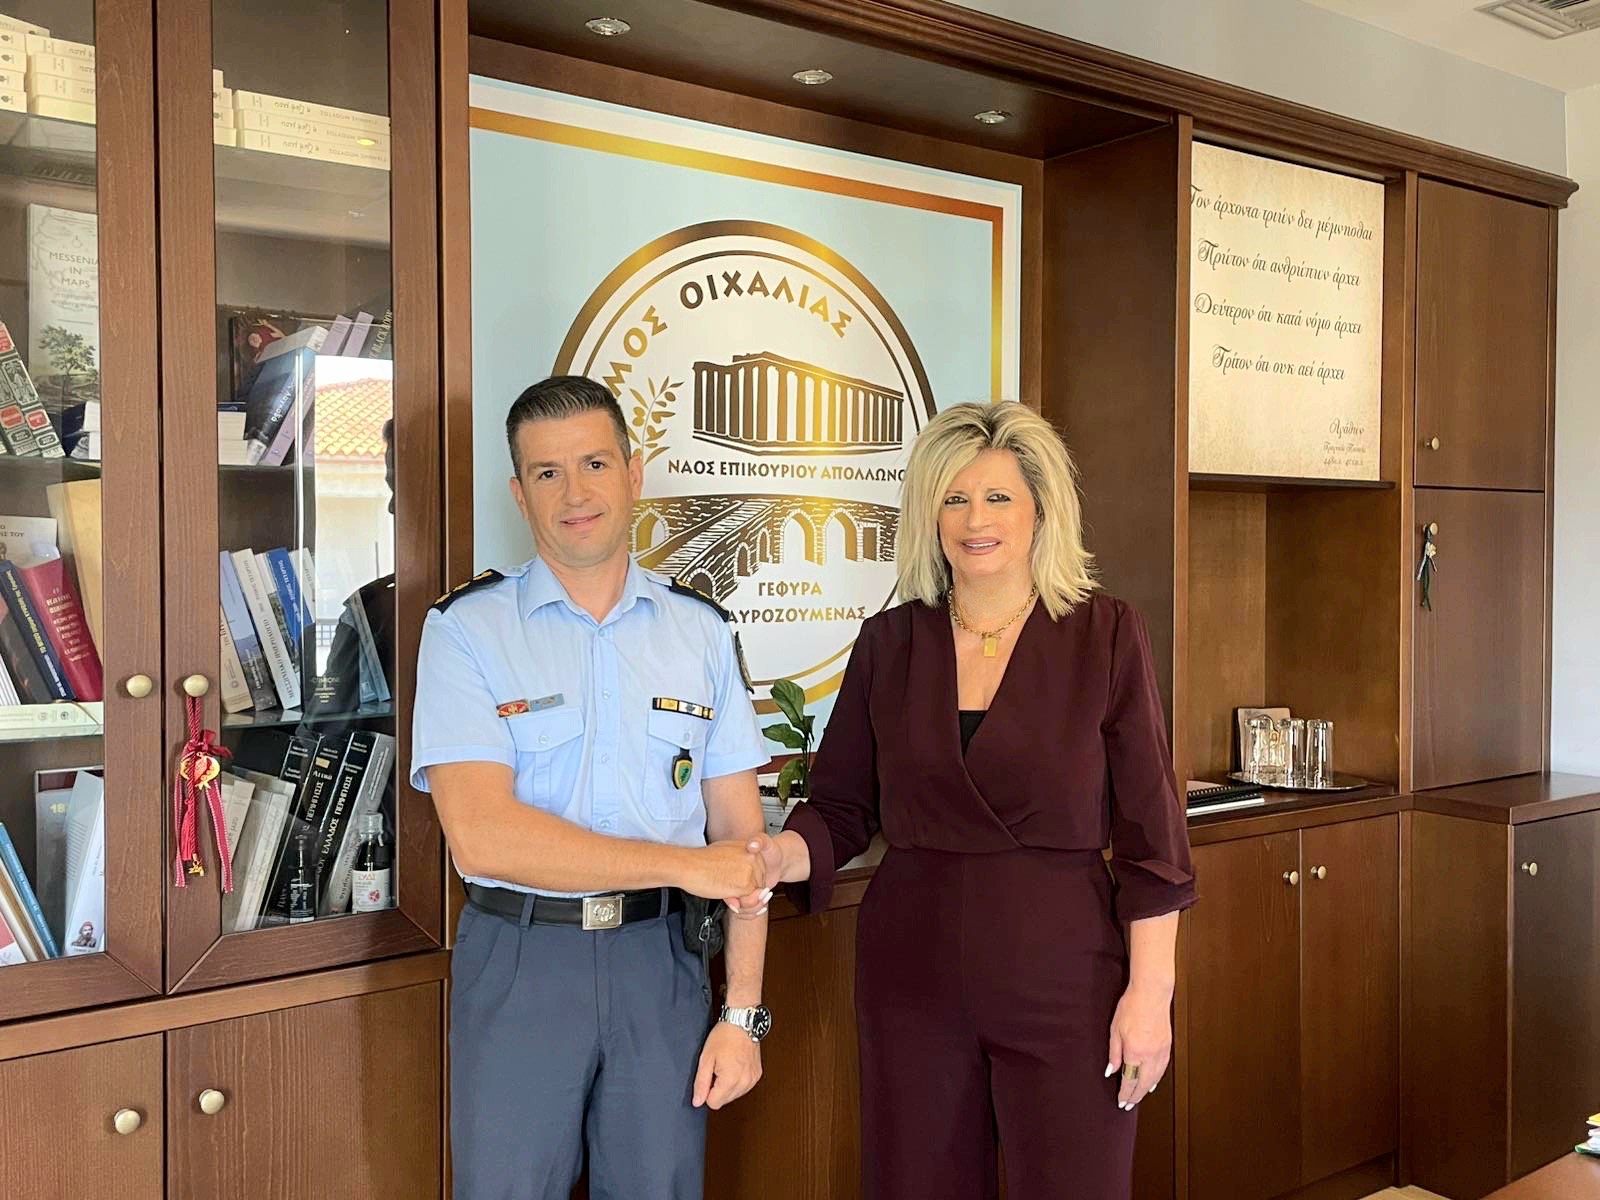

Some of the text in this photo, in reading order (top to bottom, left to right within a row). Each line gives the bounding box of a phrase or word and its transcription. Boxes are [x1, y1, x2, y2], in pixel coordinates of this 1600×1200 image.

[1213, 194, 1259, 220] άρχοντα
[1297, 209, 1313, 230] δει
[70, 266, 82, 276] IN
[1197, 238, 1360, 291] Πρώτον ότι ανθρώπων άρχει
[61, 278, 90, 289] MAPS
[602, 270, 852, 397] ΜΟΣ ΟΙΧΑΛΙΑΣ
[1194, 292, 1362, 339] Δεύτερον ότι κατά νόμο άρχει
[1212, 344, 1345, 386] Τρίτον ότι ουκ αεί άρχει
[668, 459, 905, 482] ΝΑΟΣ ΕΠΙΚΟΥΡΙΟΥ ΑΠΟΛΛΩΝΟ
[758, 580, 823, 598] ΓΕΦΥΡΑ
[728, 606, 866, 623] ΑΥΡΟΖΟΥΜΕΝΑΣ
[321, 817, 340, 854] ΕΛΛΑΔΟΣ
